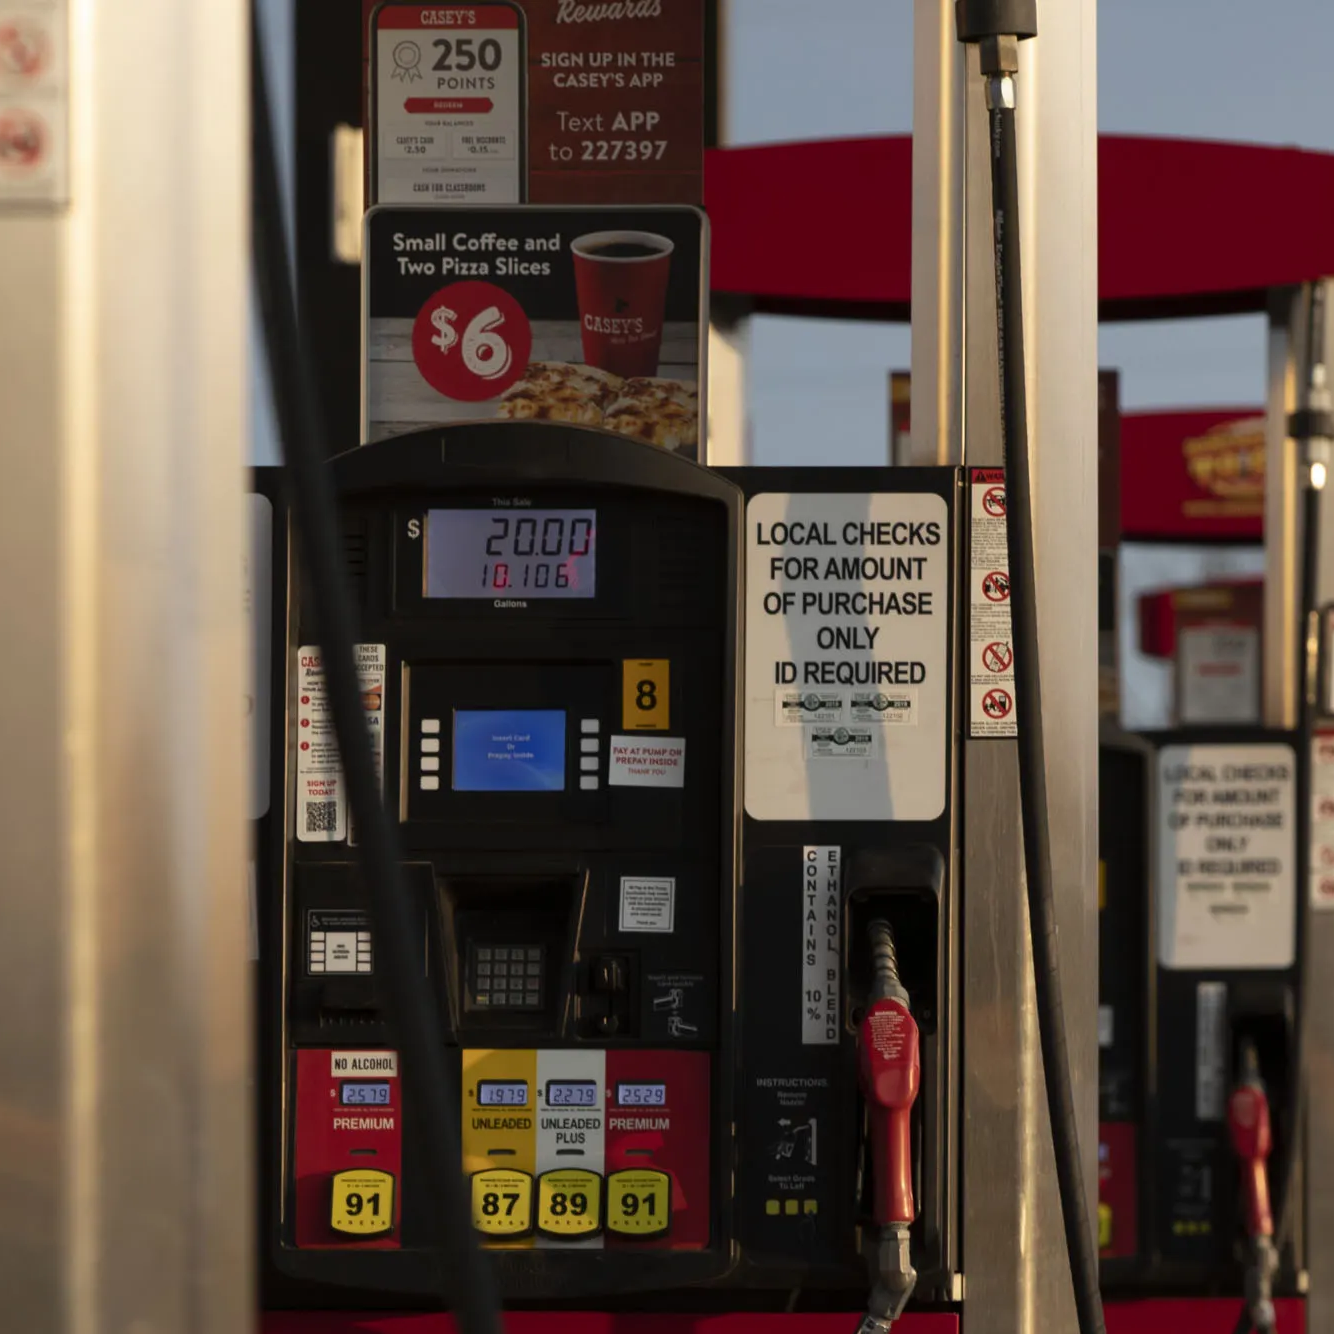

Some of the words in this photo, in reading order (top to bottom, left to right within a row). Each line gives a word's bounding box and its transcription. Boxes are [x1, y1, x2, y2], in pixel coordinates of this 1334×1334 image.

[420, 10, 476, 25] CASEY'S
[556, 0, 662, 24] Rewards
[432, 38, 502, 71] 250
[541, 52, 584, 67] SIGN
[588, 52, 613, 67] UP
[617, 52, 636, 67] IN
[641, 52, 676, 67] THE
[437, 77, 495, 90] POINTS
[553, 72, 625, 88] CASEY'S
[629, 73, 664, 88] APP
[556, 111, 604, 132] Text
[611, 111, 660, 132] APP
[549, 142, 573, 161] to
[581, 140, 668, 160] 227397
[392, 233, 446, 252] Small
[452, 233, 519, 252] Coffee
[524, 233, 561, 252] and
[397, 257, 435, 276] Two
[442, 257, 489, 276] Pizza
[495, 257, 551, 276] Slices
[584, 313, 643, 334] CASEY'S
[430, 305, 513, 380] $6
[407, 518, 420, 539] $
[486, 518, 592, 556] 20.00
[757, 522, 836, 546] LOCAL
[842, 522, 941, 546] CHECKS
[482, 564, 569, 588] 10.106
[770, 557, 819, 580] FOR
[824, 557, 927, 580] AMOUNT
[494, 599, 527, 608] Gallons
[763, 592, 796, 615] OF
[802, 592, 932, 615] PURCHASE
[817, 626, 880, 650] ONLY
[775, 661, 797, 684] ID
[803, 661, 926, 686] REQUIRED
[636, 680, 657, 711] 8
[613, 747, 628, 755] PAY
[630, 747, 640, 755] AT
[642, 748, 668, 757] PUMP
[670, 749, 682, 757] OR
[616, 757, 647, 766] PREPAY
[649, 758, 678, 767] INSIDE
[806, 850, 817, 966] CONTAINS
[826, 850, 838, 953] ETHANOL
[826, 969, 837, 1040] BLEND
[334, 1059, 348, 1070] NO
[351, 1058, 394, 1070] ALCOHOL
[756, 1078, 828, 1087] INSTRUCTIONS
[333, 1118, 394, 1130] PREMIUM
[472, 1118, 531, 1130] UNLEADED
[541, 1118, 601, 1130] UNLEADED
[609, 1118, 670, 1130] PREMIUM
[556, 1132, 585, 1144] PLUS
[346, 1193, 380, 1216] 91
[482, 1192, 520, 1216] 87
[550, 1192, 587, 1216] 89
[621, 1192, 656, 1216] 91
